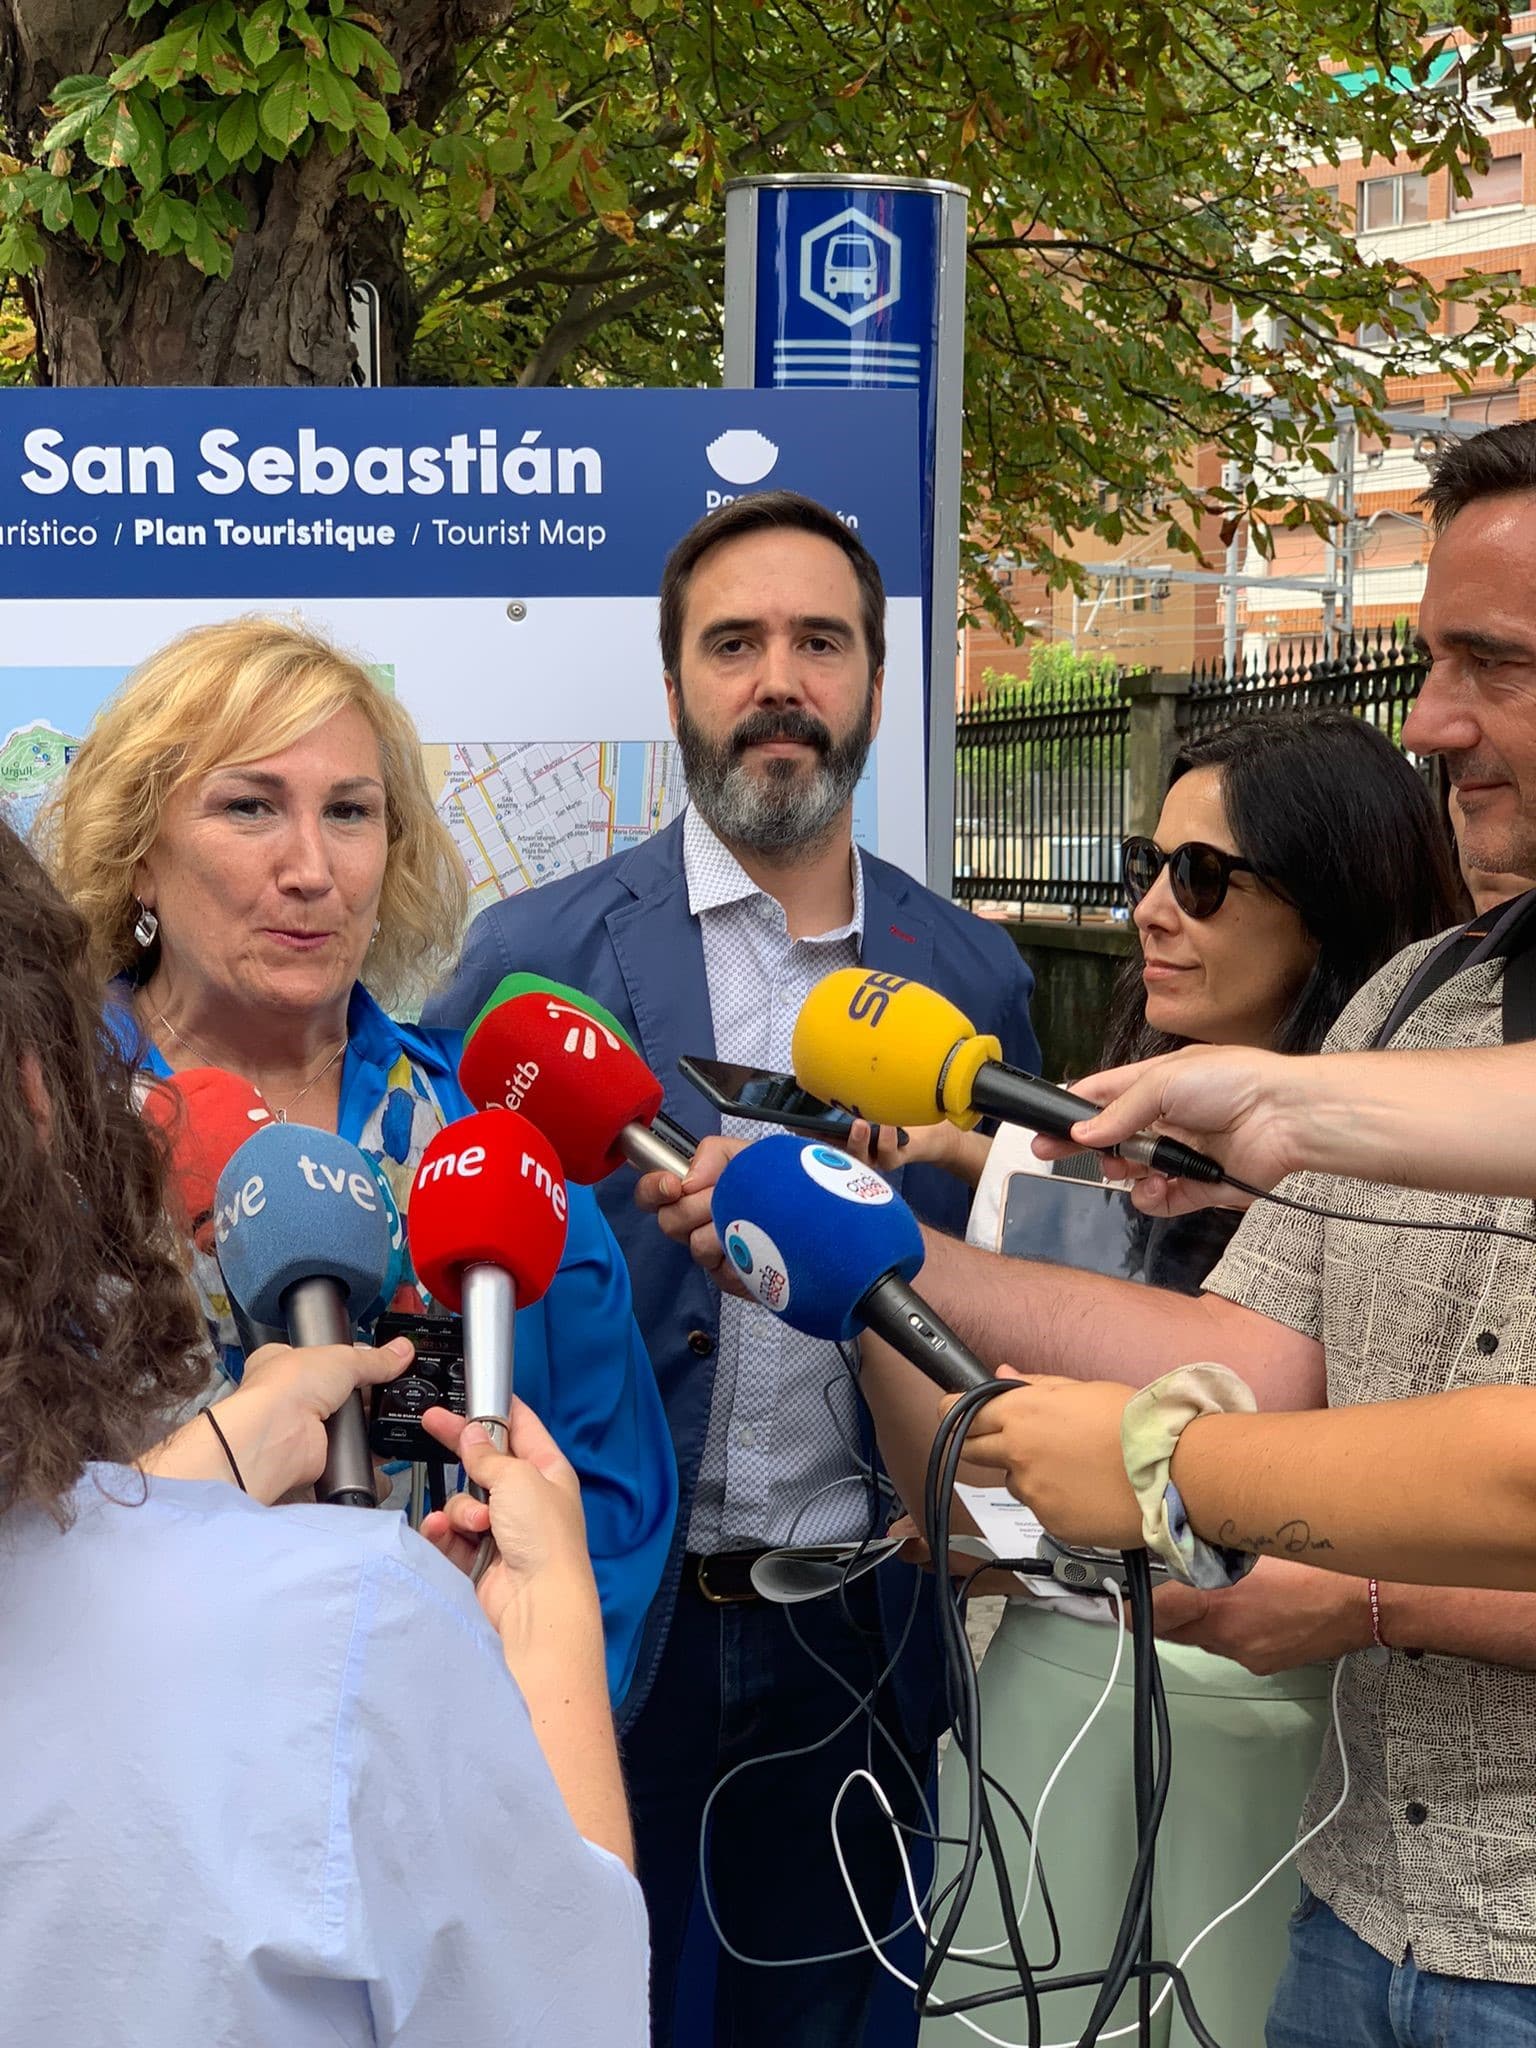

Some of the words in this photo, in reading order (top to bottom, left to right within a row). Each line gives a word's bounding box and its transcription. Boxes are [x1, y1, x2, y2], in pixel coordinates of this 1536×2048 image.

[21, 428, 175, 496] San
[196, 428, 602, 496] Sebastián
[134, 518, 206, 546] Plan
[214, 518, 396, 552] Touristique
[432, 519, 531, 545] Tourist
[540, 519, 606, 551] Map
[1, 766, 32, 778] Urgull
[505, 1061, 540, 1111] eitb
[297, 1154, 377, 1212] tve
[418, 1145, 486, 1190] rne
[520, 1151, 567, 1222] rne
[214, 1175, 267, 1244] tve
